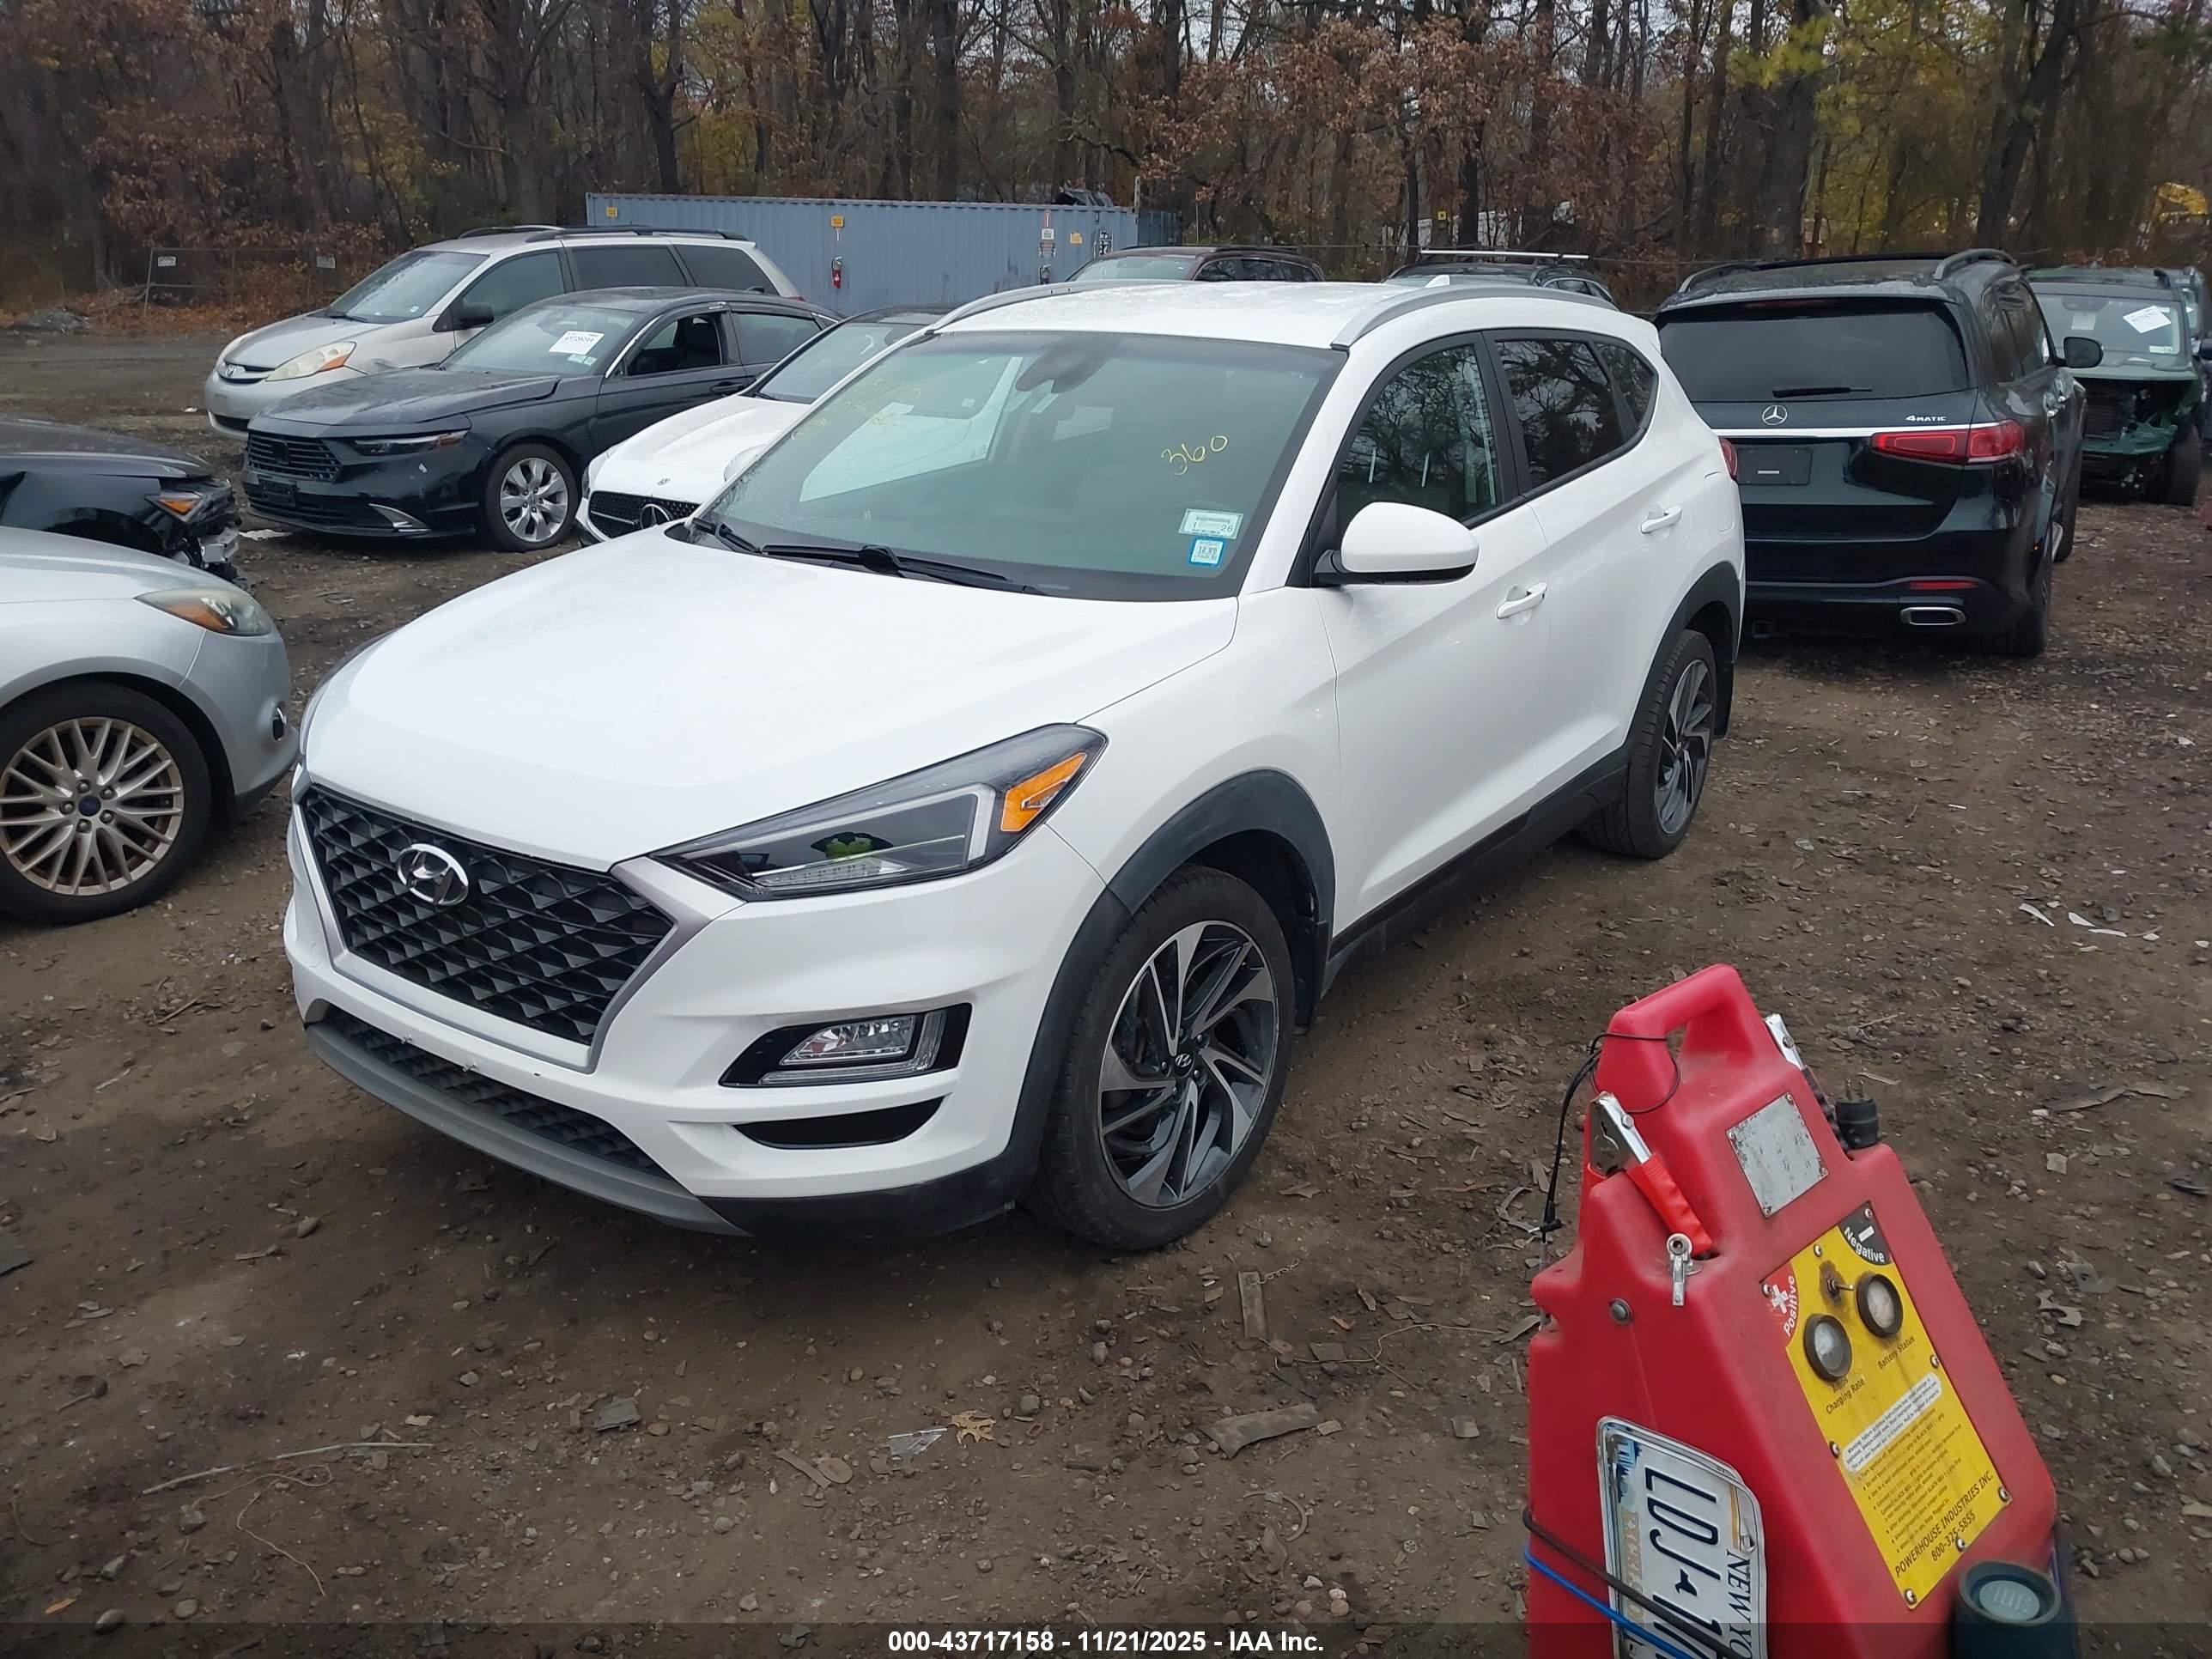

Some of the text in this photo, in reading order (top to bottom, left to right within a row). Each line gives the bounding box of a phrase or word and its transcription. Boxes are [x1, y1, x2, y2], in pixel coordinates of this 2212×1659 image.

[1161, 434, 1228, 476] 360
[1220, 524, 1233, 532] 26
[1844, 1226, 1885, 1263] Negative
[1784, 1275, 1797, 1337] Positive
[1877, 1336, 1915, 1370] Battery Status
[1826, 1378, 1865, 1415] Charging Rate
[1644, 1468, 1721, 1581] LDJ
[1895, 1524, 1942, 1577] POWERHOUSE
[1941, 1484, 1980, 1529] INDUSTRIES
[1978, 1470, 1994, 1489] INC.
[1931, 1510, 1977, 1561] 800-325-5855
[1727, 1548, 1752, 1623] NEW
